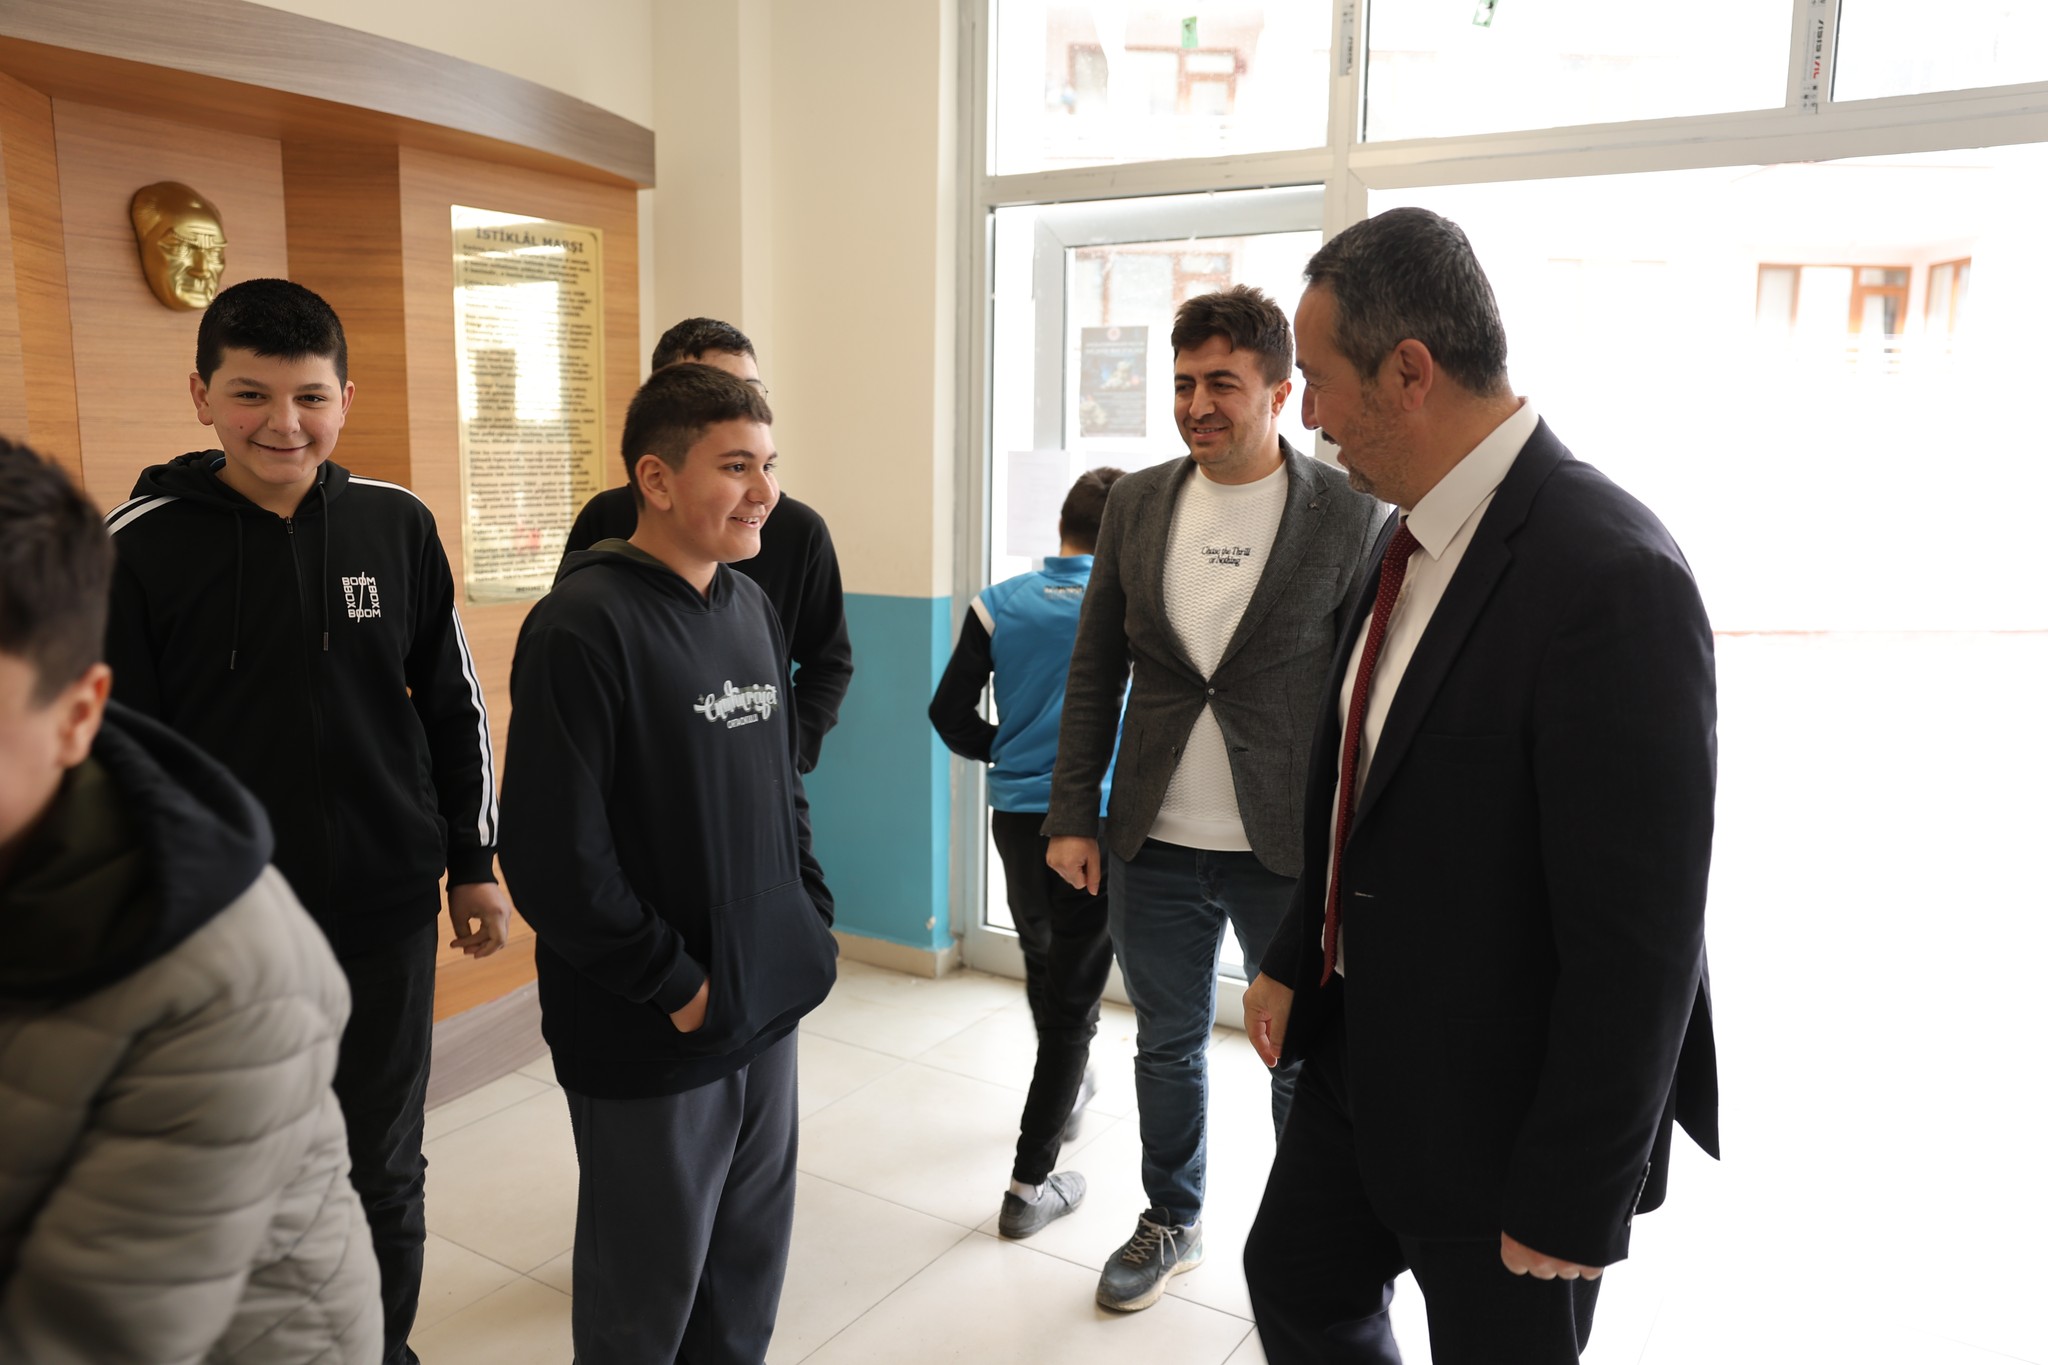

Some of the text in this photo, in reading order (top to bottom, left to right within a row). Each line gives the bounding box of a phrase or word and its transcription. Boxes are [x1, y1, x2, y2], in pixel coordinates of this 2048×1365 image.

[1201, 546, 1251, 556] Chase the Thrill
[1215, 554, 1241, 567] Nothing
[341, 576, 376, 585] BOOM
[343, 585, 356, 608] BOX
[368, 585, 380, 608] BOX
[347, 609, 381, 618] BOOM
